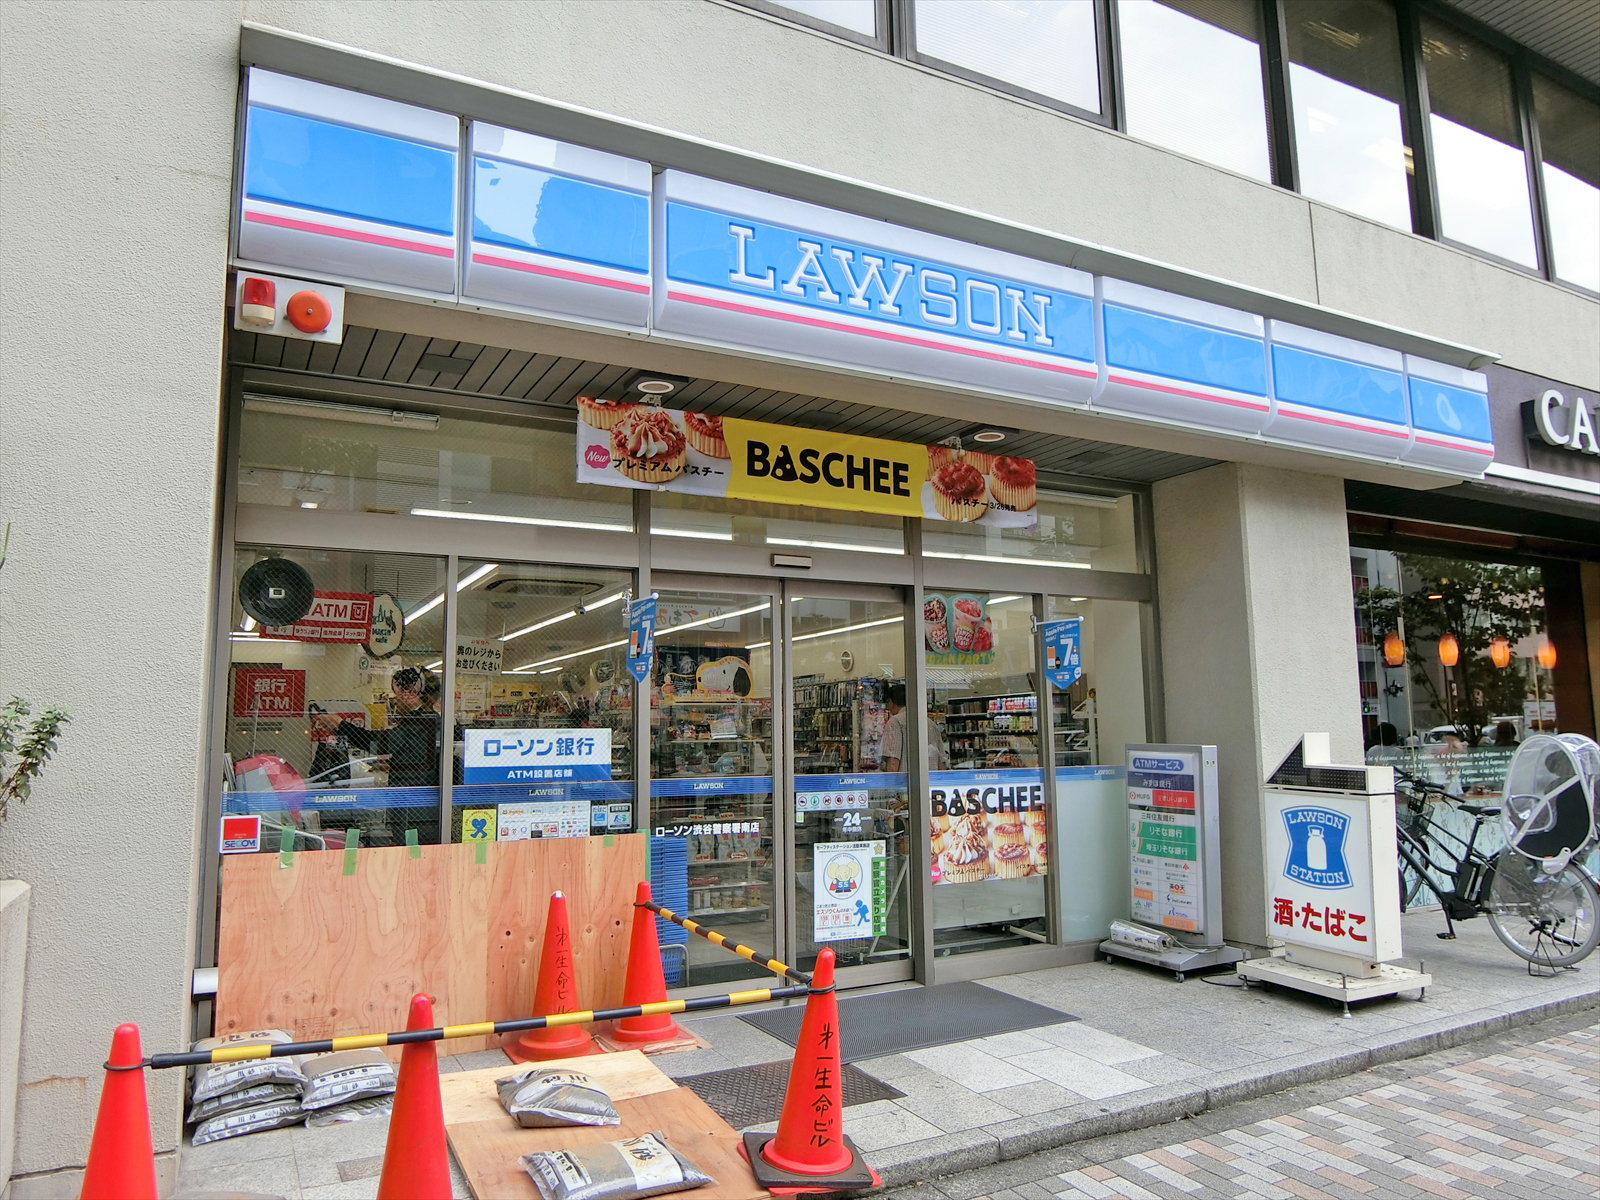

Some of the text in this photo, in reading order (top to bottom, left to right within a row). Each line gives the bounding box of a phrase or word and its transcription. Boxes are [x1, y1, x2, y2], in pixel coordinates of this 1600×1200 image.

[729, 222, 1054, 348] LAWSON
[1536, 389, 1600, 455] CA
[586, 451, 609, 463] New
[746, 440, 910, 497] BASCHEE
[951, 498, 988, 507] バスチー
[311, 603, 348, 618] ATM
[642, 620, 651, 655] 7
[457, 645, 501, 659] 奥のレジから
[1060, 638, 1079, 666] 7 倍
[456, 658, 500, 671] お並びください
[254, 679, 287, 693] 銀行
[250, 697, 289, 710] ATM
[483, 737, 595, 757] ローソン銀行
[1135, 759, 1181, 770] ATMサービス
[507, 769, 573, 779] ATM設置店舗
[1142, 779, 1172, 788] みずほ銀行
[528, 788, 564, 796] LAWSON
[1157, 795, 1188, 803] 三菱UFJ銀行
[931, 785, 1043, 817] BASCHEE
[843, 812, 862, 826] 24
[1141, 812, 1175, 822] 三井住友銀行
[1287, 811, 1344, 830] LAWSON
[655, 822, 760, 837] ローソン渋谷警察署南店
[1149, 826, 1183, 838] りそな銀行
[224, 839, 256, 848] SECOM
[1146, 842, 1188, 856] 埼玉りそな銀行
[1290, 864, 1345, 885] STATION
[1273, 897, 1368, 942] 酒・たばこ
